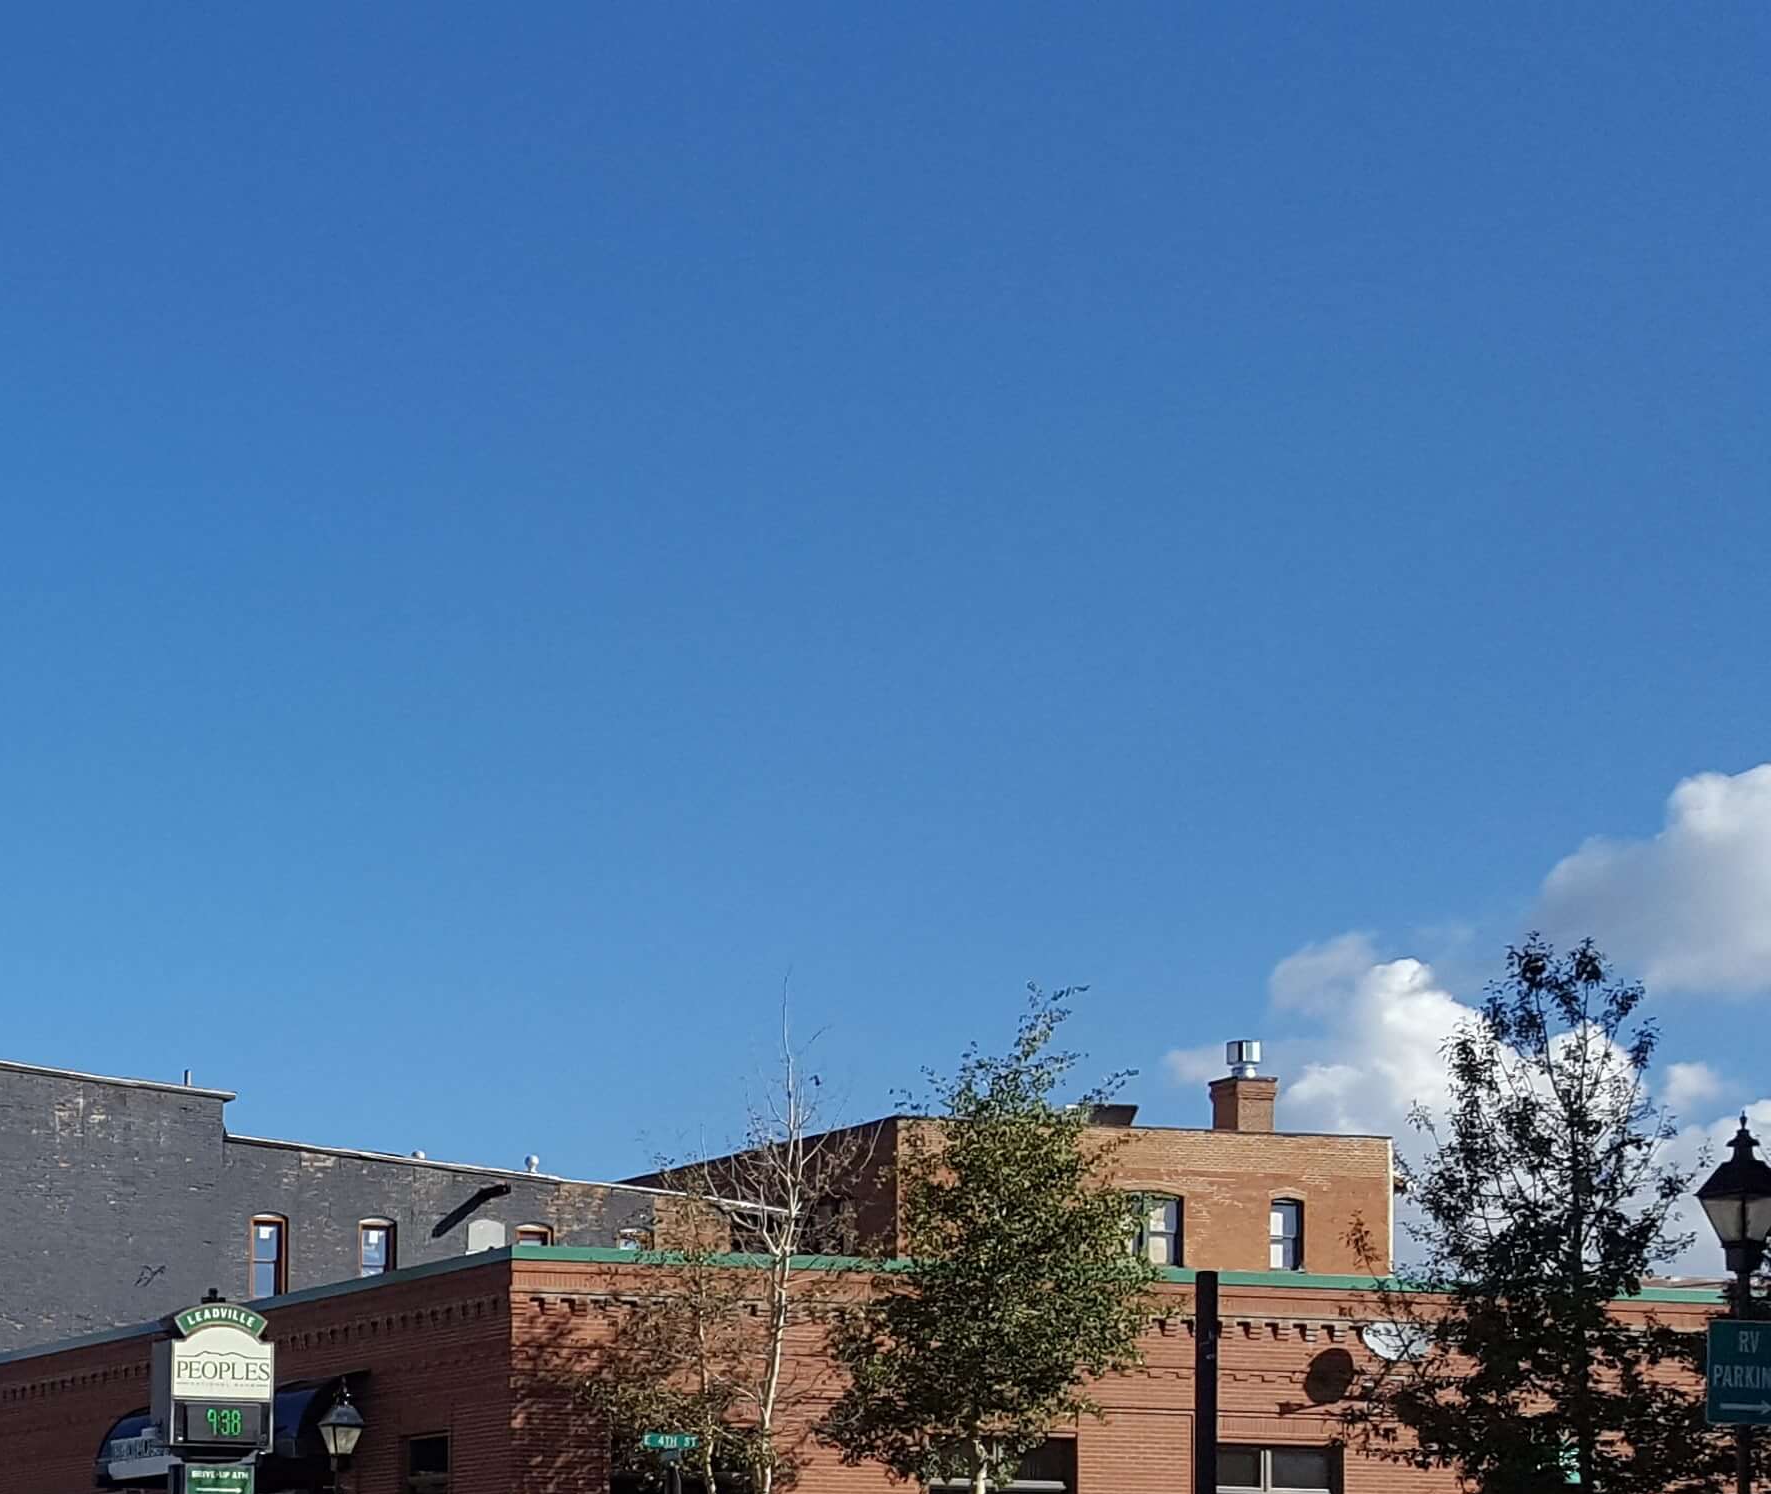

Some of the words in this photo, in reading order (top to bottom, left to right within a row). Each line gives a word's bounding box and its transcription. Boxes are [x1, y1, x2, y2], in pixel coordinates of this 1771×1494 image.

[186, 1307, 256, 1328] LEADVILLE
[1738, 1330, 1761, 1354] RV
[176, 1360, 271, 1381] PEOPLES
